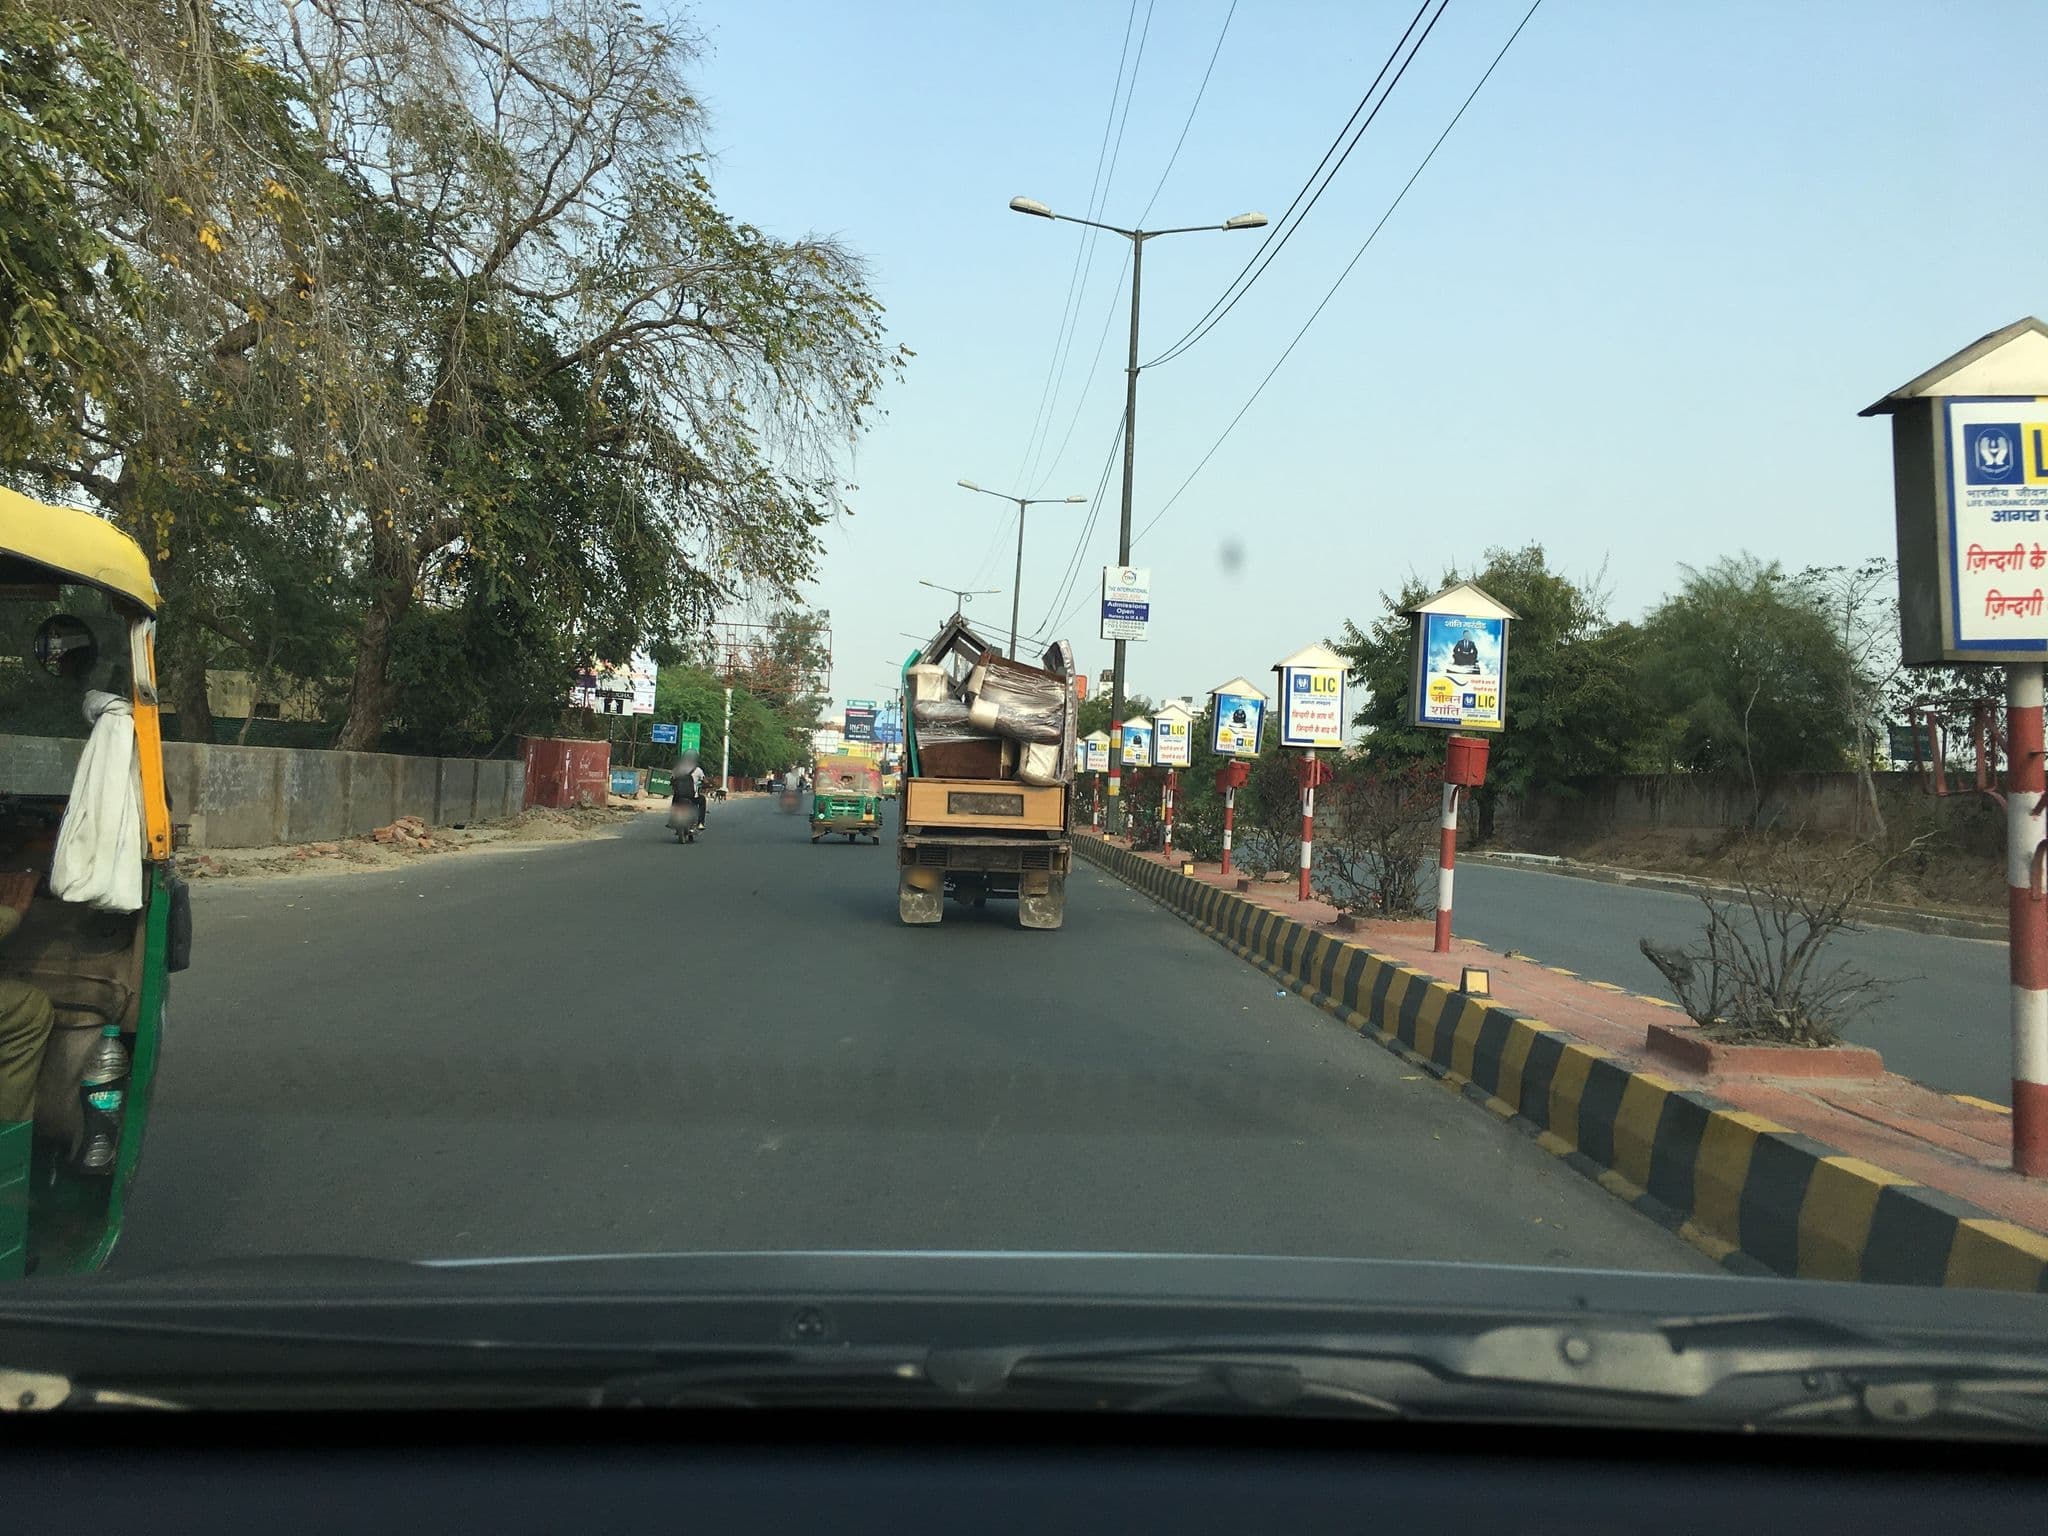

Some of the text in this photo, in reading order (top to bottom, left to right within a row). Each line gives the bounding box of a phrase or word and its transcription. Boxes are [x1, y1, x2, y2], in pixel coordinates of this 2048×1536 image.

[1991, 509, 2040, 522] आगरा
[1107, 601, 1147, 610] Admissions
[1116, 607, 1135, 615] Open
[1314, 676, 1337, 693] LIC
[1431, 692, 1461, 704] जीवन
[1478, 694, 1496, 709] LIC
[1431, 704, 1461, 717] शांति
[1171, 724, 1186, 736] LIC
